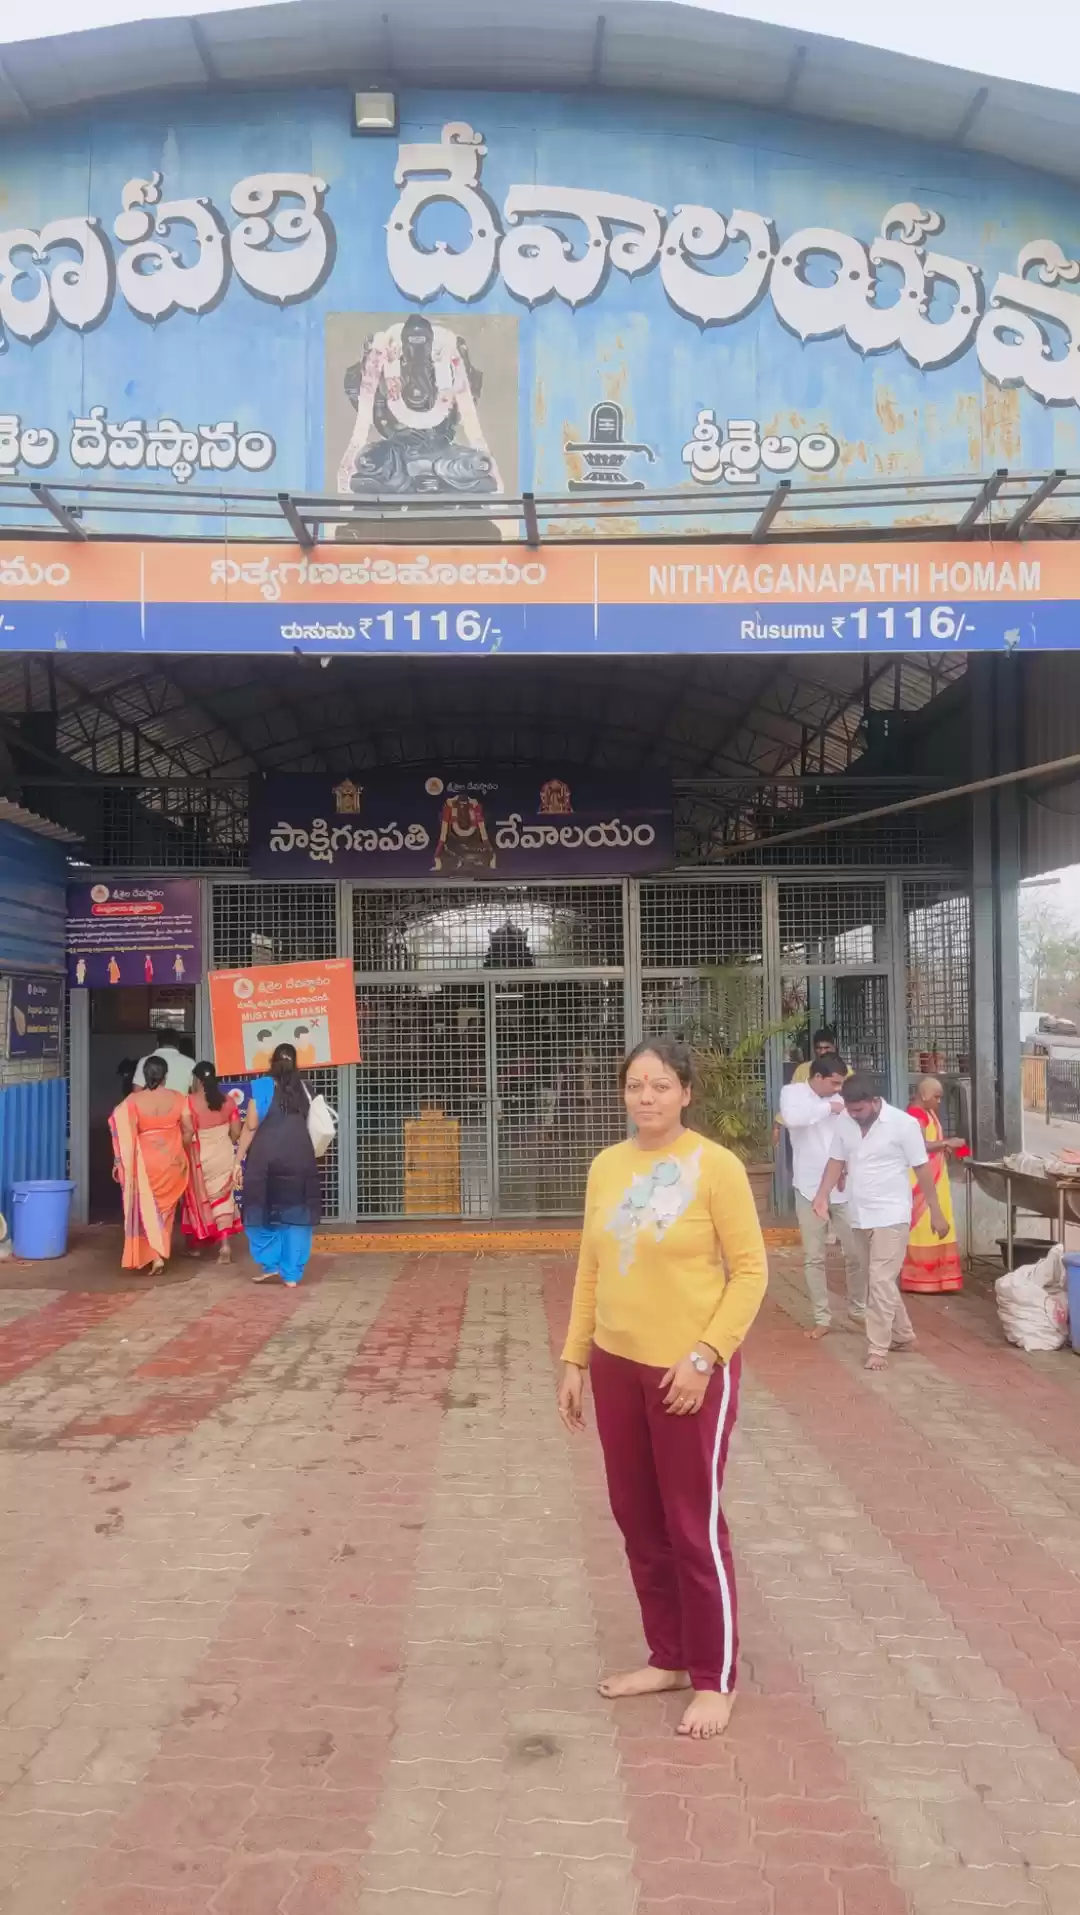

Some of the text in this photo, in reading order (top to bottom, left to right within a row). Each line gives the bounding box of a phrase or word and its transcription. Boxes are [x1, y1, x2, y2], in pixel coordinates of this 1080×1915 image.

[0, 170, 334, 346] ణపతి
[71, 405, 276, 484] దేవస్థానం
[681, 409, 839, 485] శ్రీశైలం
[648, 560, 1042, 597] NITHYAGANAPATHI HOMAM
[358, 609, 502, 644] ₹1116/-
[740, 605, 976, 642] Rusumu ₹1116/-
[269, 812, 656, 864] సాక్షిగణపతి దేవాలయం
[241, 1005, 328, 1021] MUST WEAR MASK
